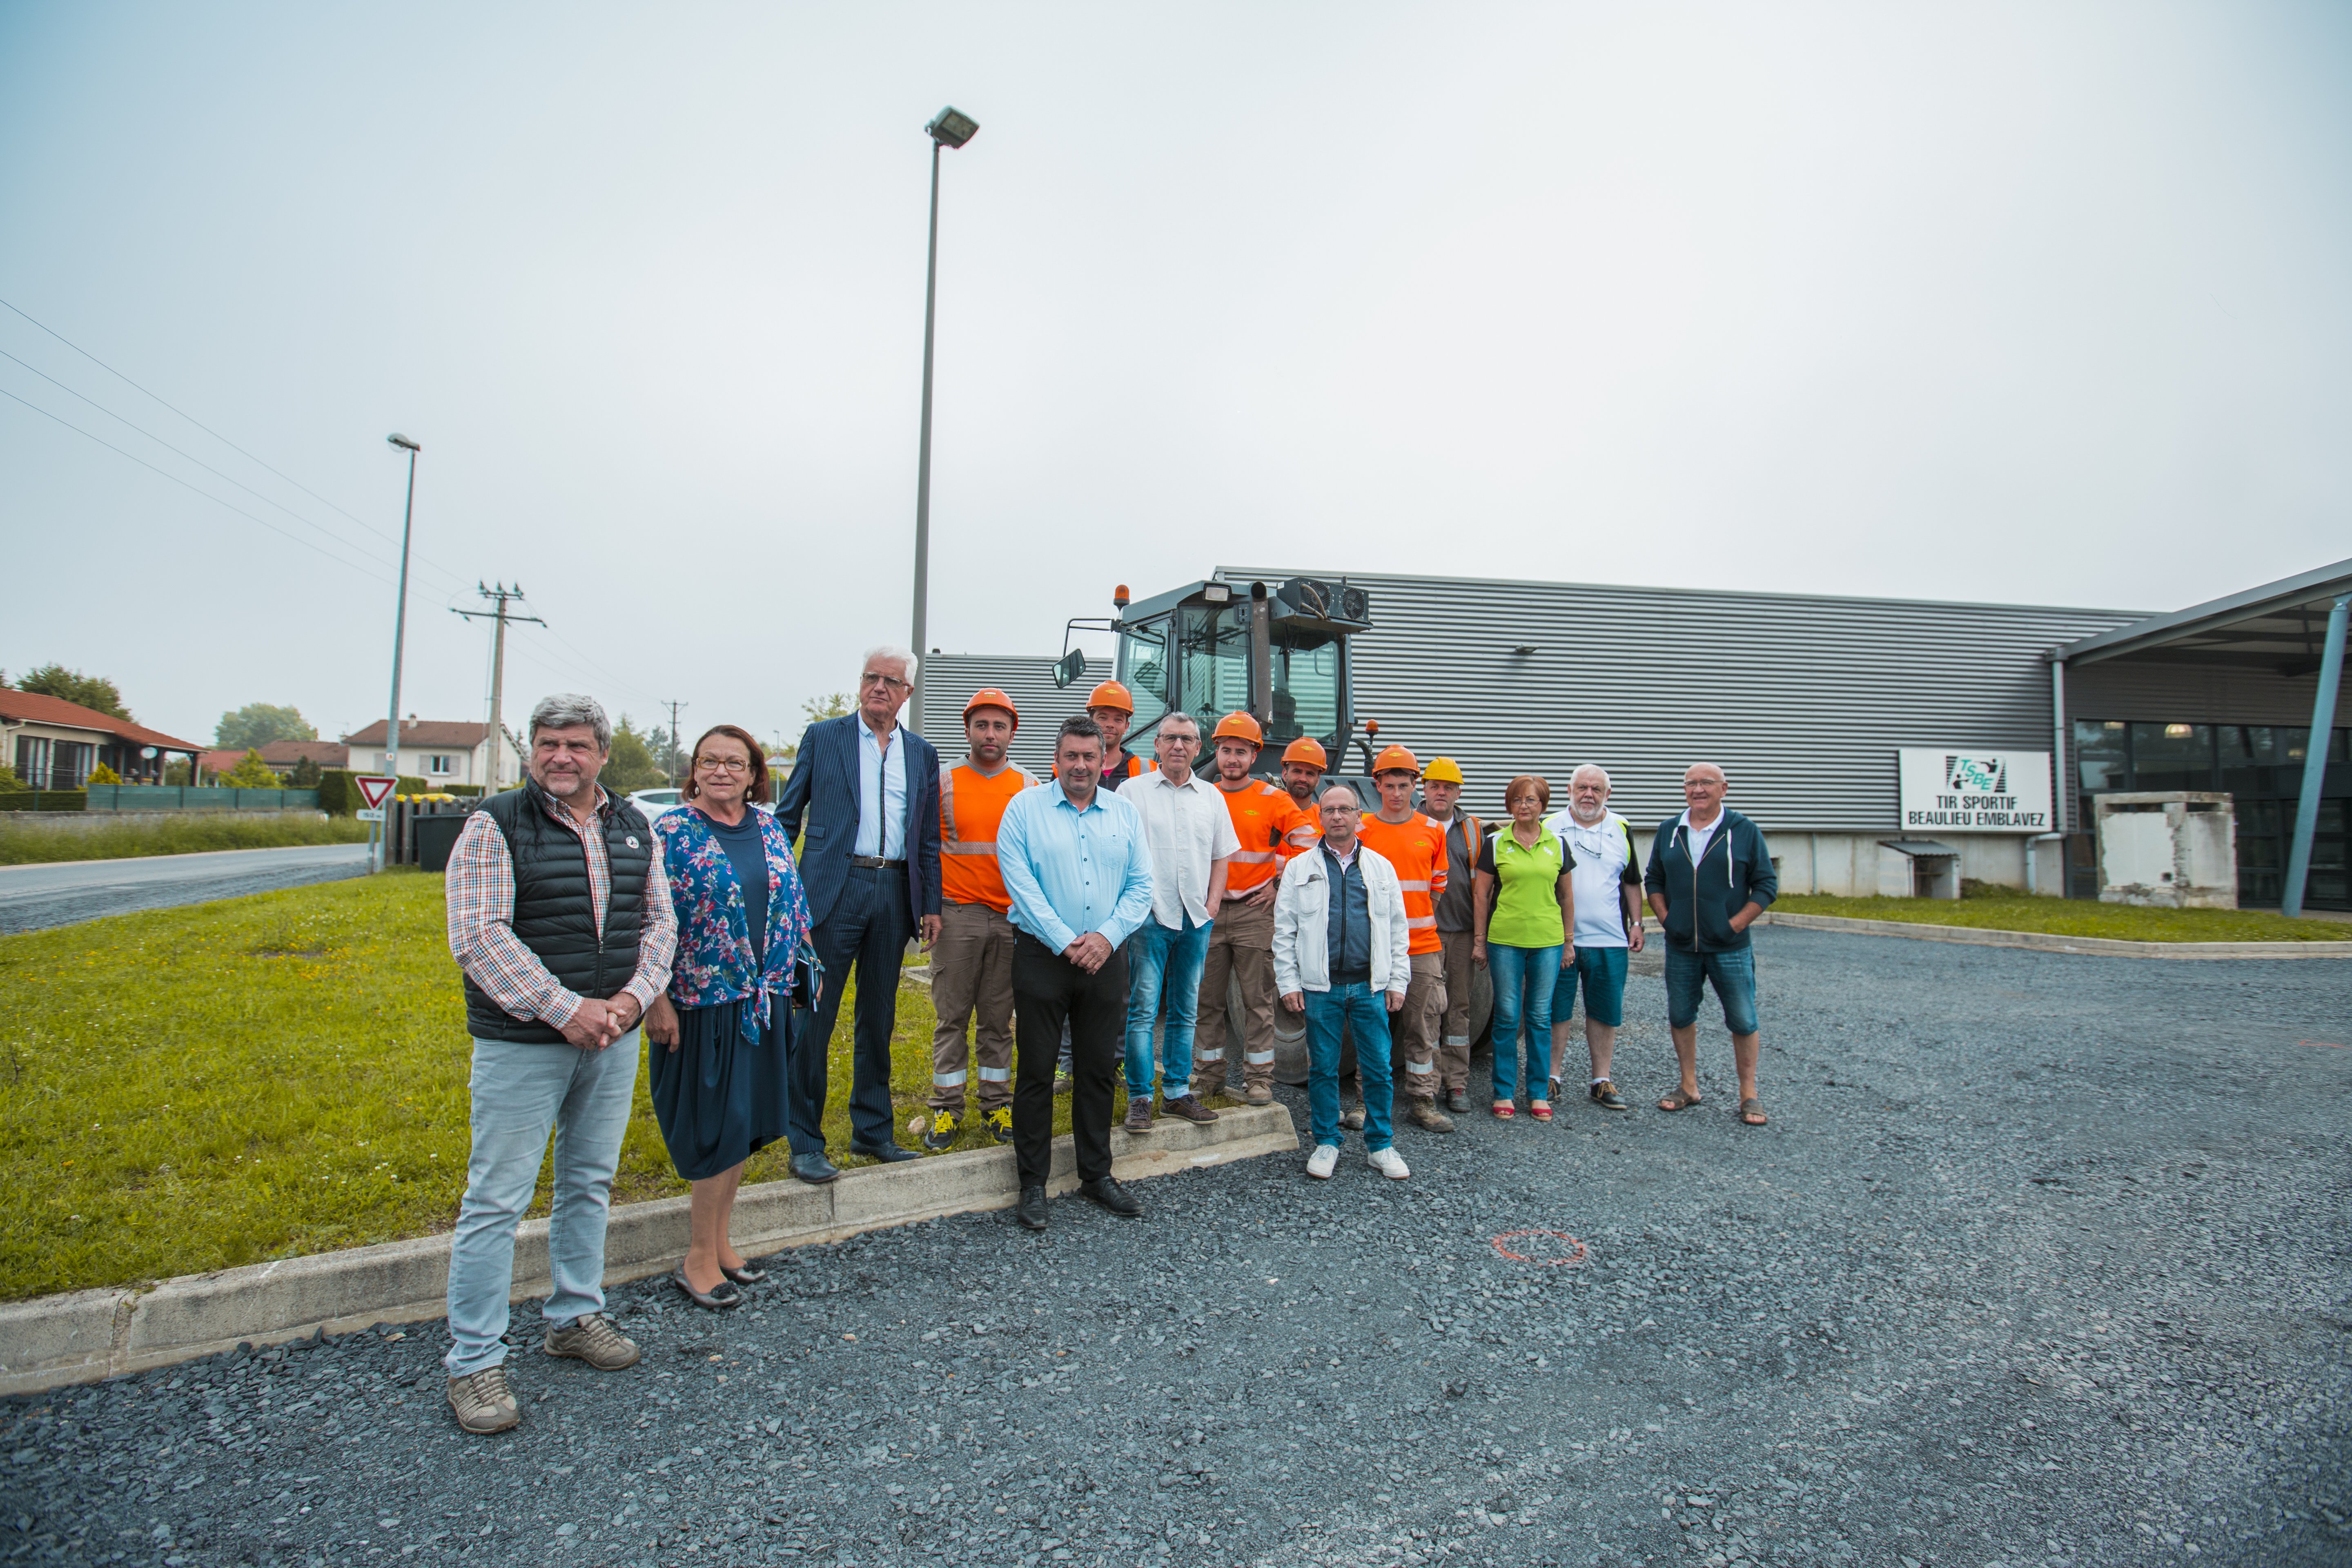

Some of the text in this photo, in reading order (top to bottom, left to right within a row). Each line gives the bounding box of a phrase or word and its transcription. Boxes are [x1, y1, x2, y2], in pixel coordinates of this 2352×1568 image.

[1937, 796, 2018, 809] TIR SPORTIF
[1909, 811, 2045, 826] BEAULIEU EMBLAVEZ
